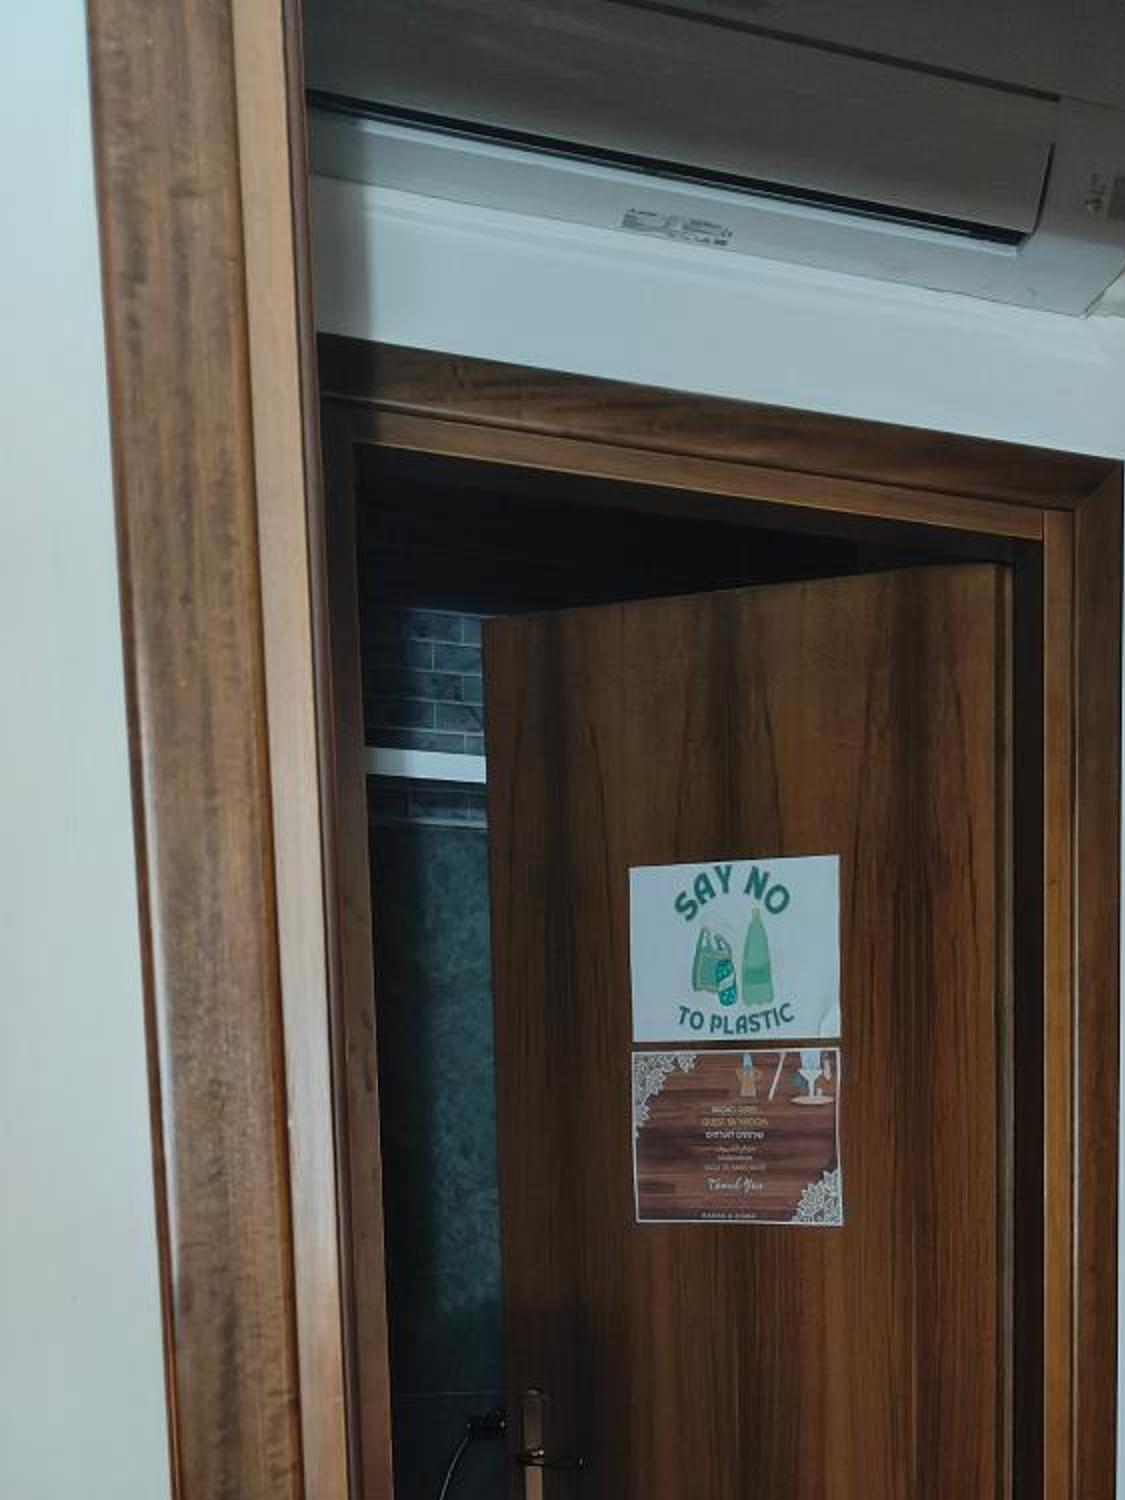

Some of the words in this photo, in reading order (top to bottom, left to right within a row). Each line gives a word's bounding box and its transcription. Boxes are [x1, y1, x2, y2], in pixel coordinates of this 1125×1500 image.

[674, 864, 733, 922] SAY
[744, 865, 791, 915] NO
[678, 1005, 705, 1031] TO
[709, 1002, 795, 1035] PLASTIC
